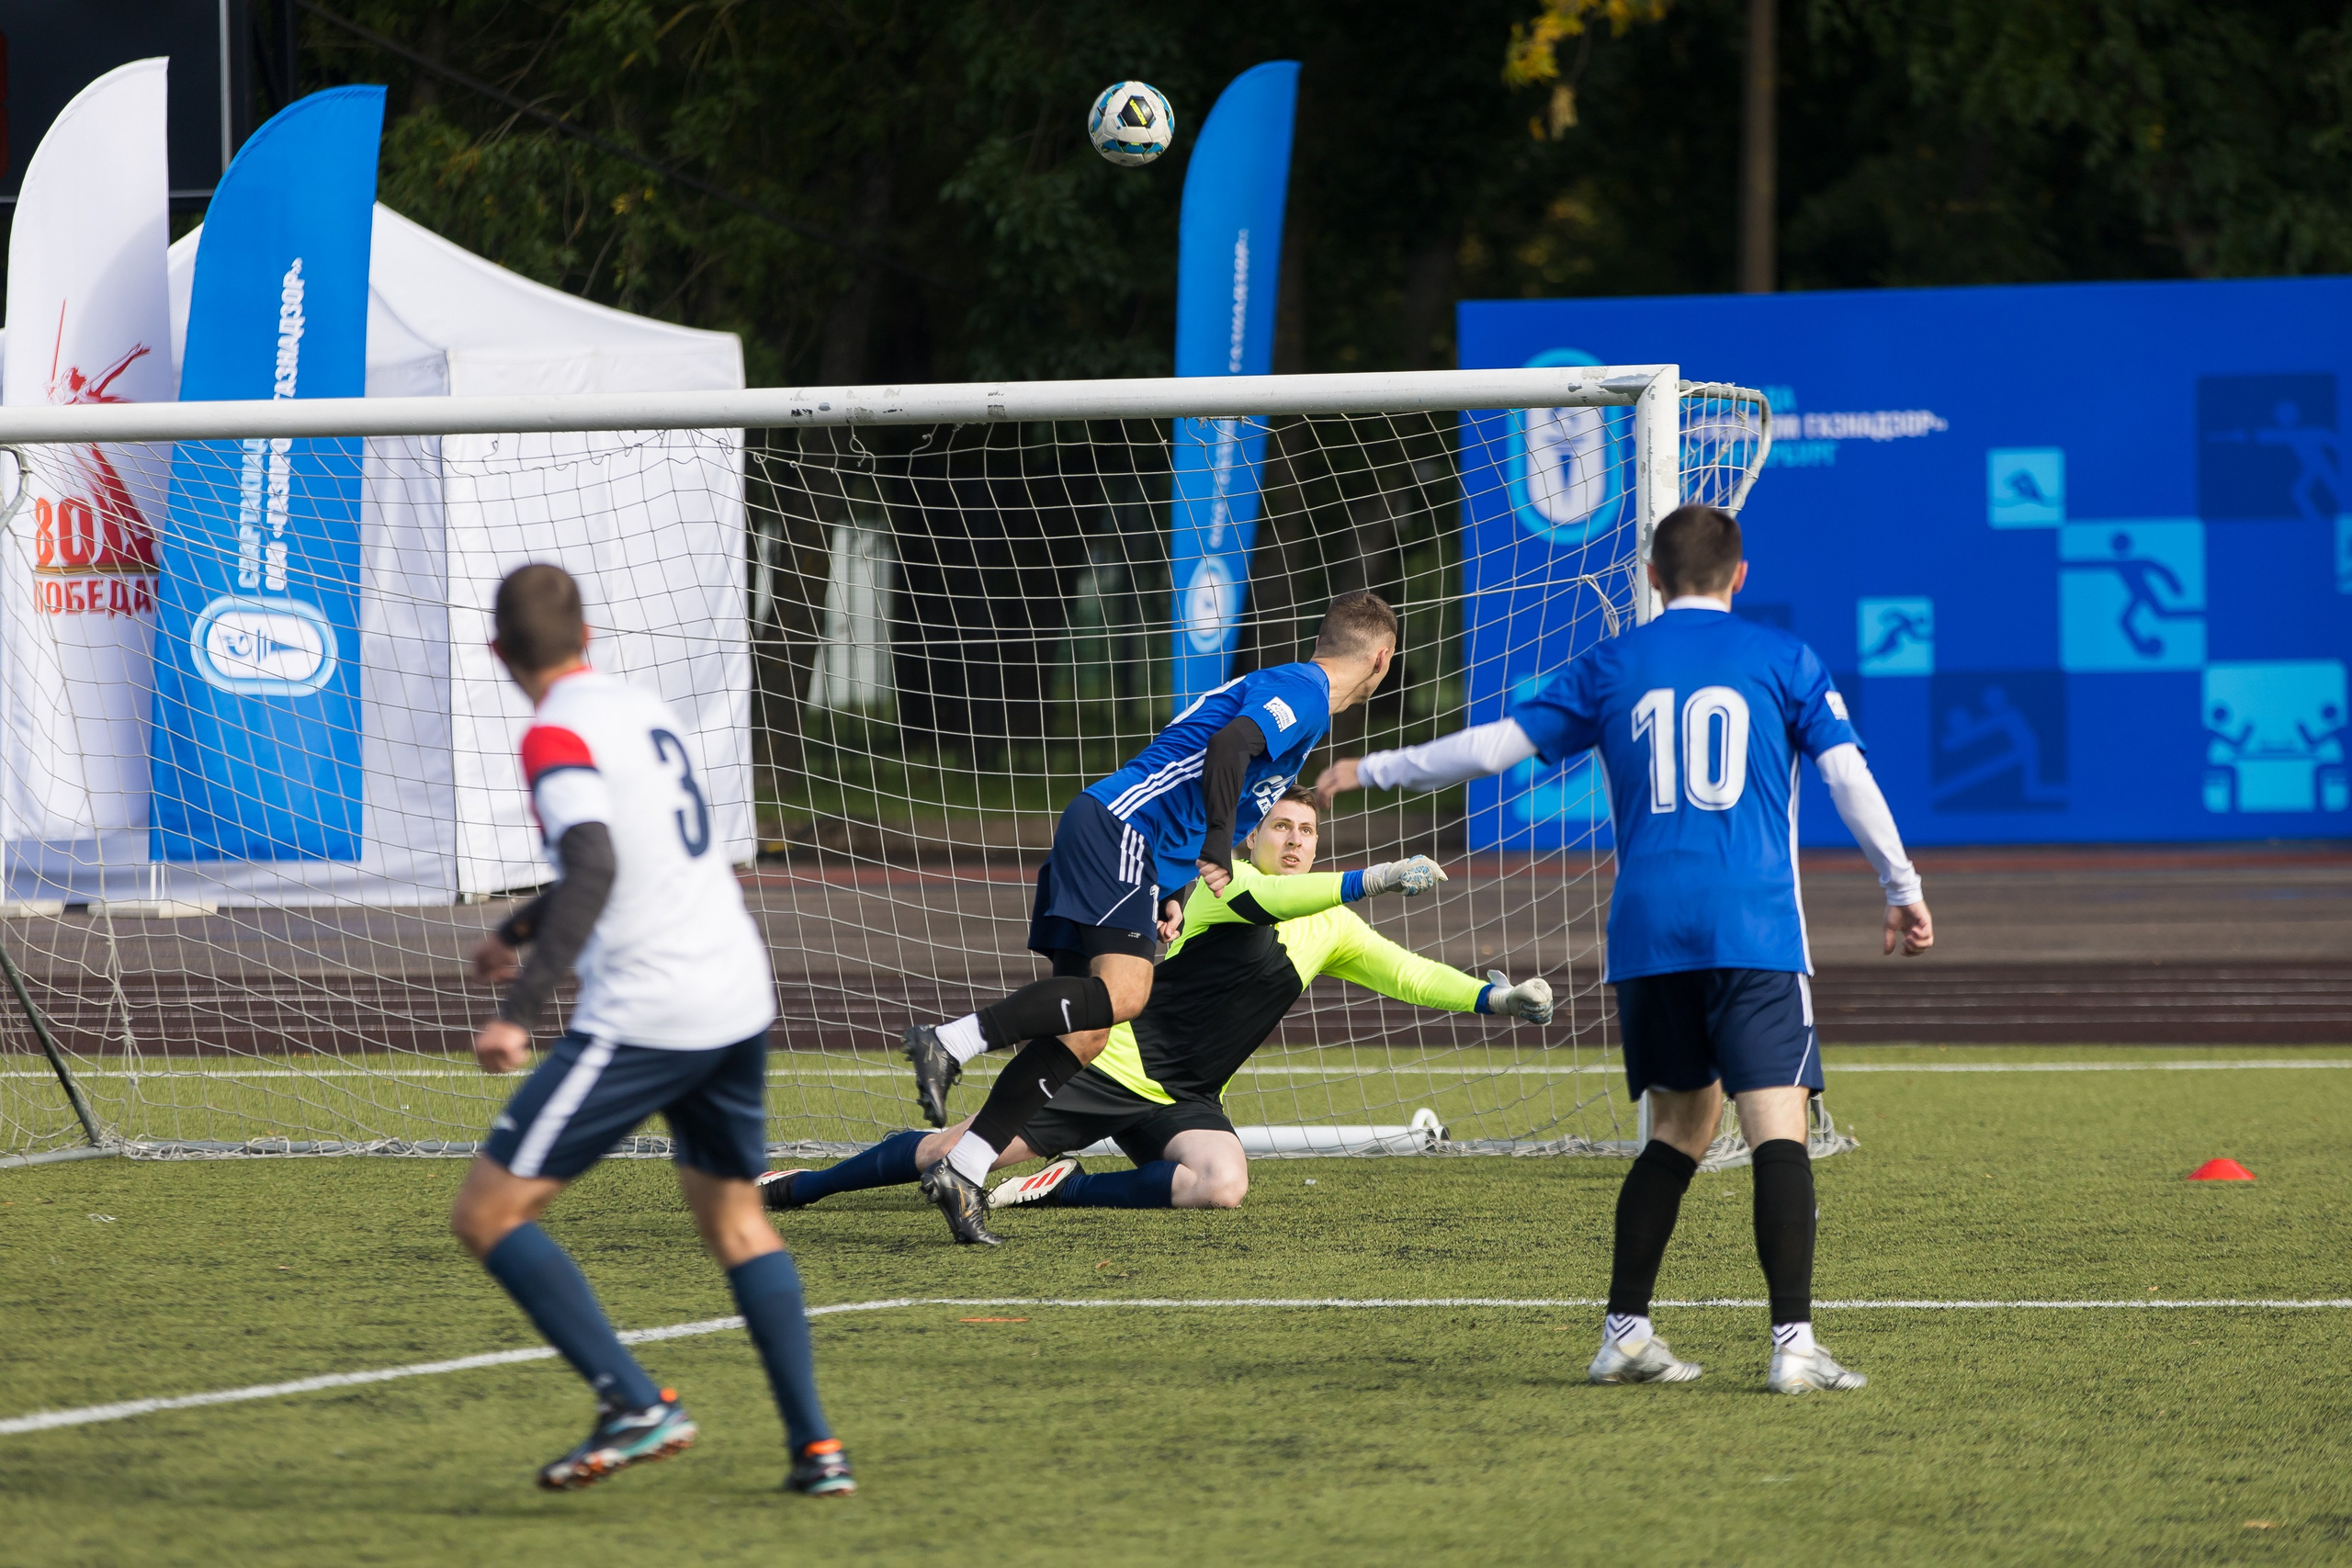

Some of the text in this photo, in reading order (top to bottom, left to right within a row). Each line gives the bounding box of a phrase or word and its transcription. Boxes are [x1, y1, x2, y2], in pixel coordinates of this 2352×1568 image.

[238, 438, 268, 589] СПАРТАКИАД
[266, 438, 293, 539] «ГАЗПРО
[650, 728, 709, 859] 3
[1630, 685, 1750, 815] 10
